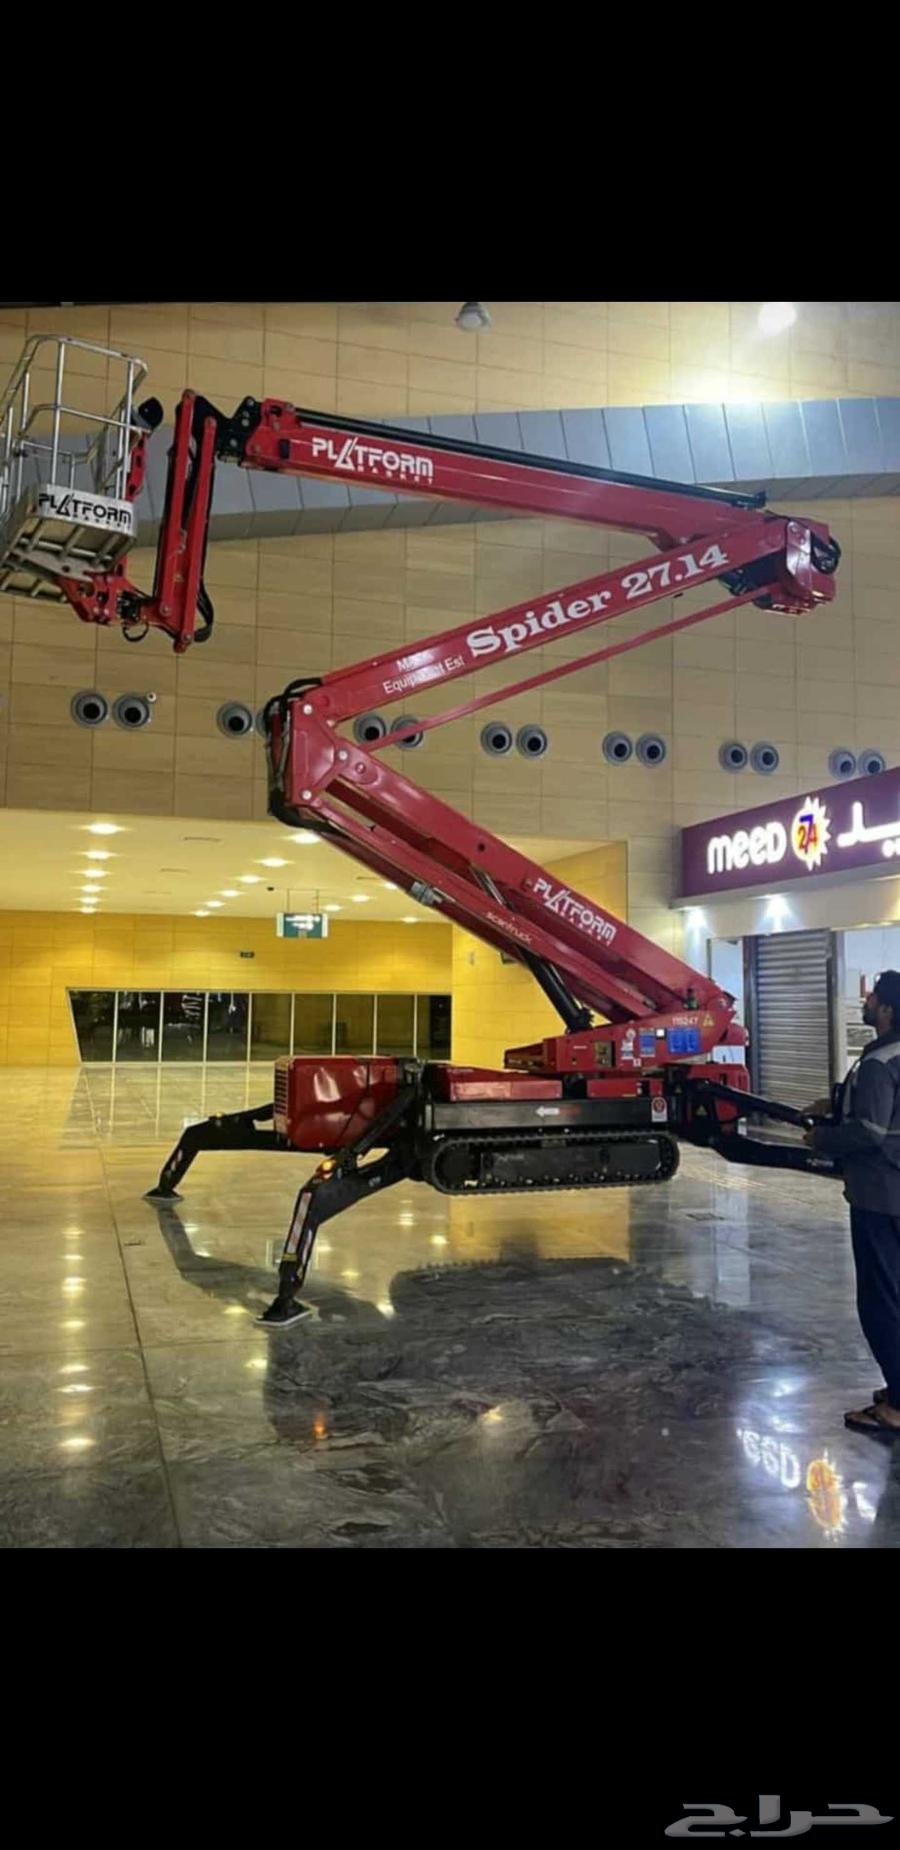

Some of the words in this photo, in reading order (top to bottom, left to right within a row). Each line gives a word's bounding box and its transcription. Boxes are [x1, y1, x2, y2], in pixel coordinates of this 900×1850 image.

[312, 437, 434, 477] PLATFORM
[38, 492, 132, 525] PLATFORM
[466, 589, 611, 658] Spider
[621, 544, 729, 600] 27.14
[533, 878, 617, 940] PLATFORM
